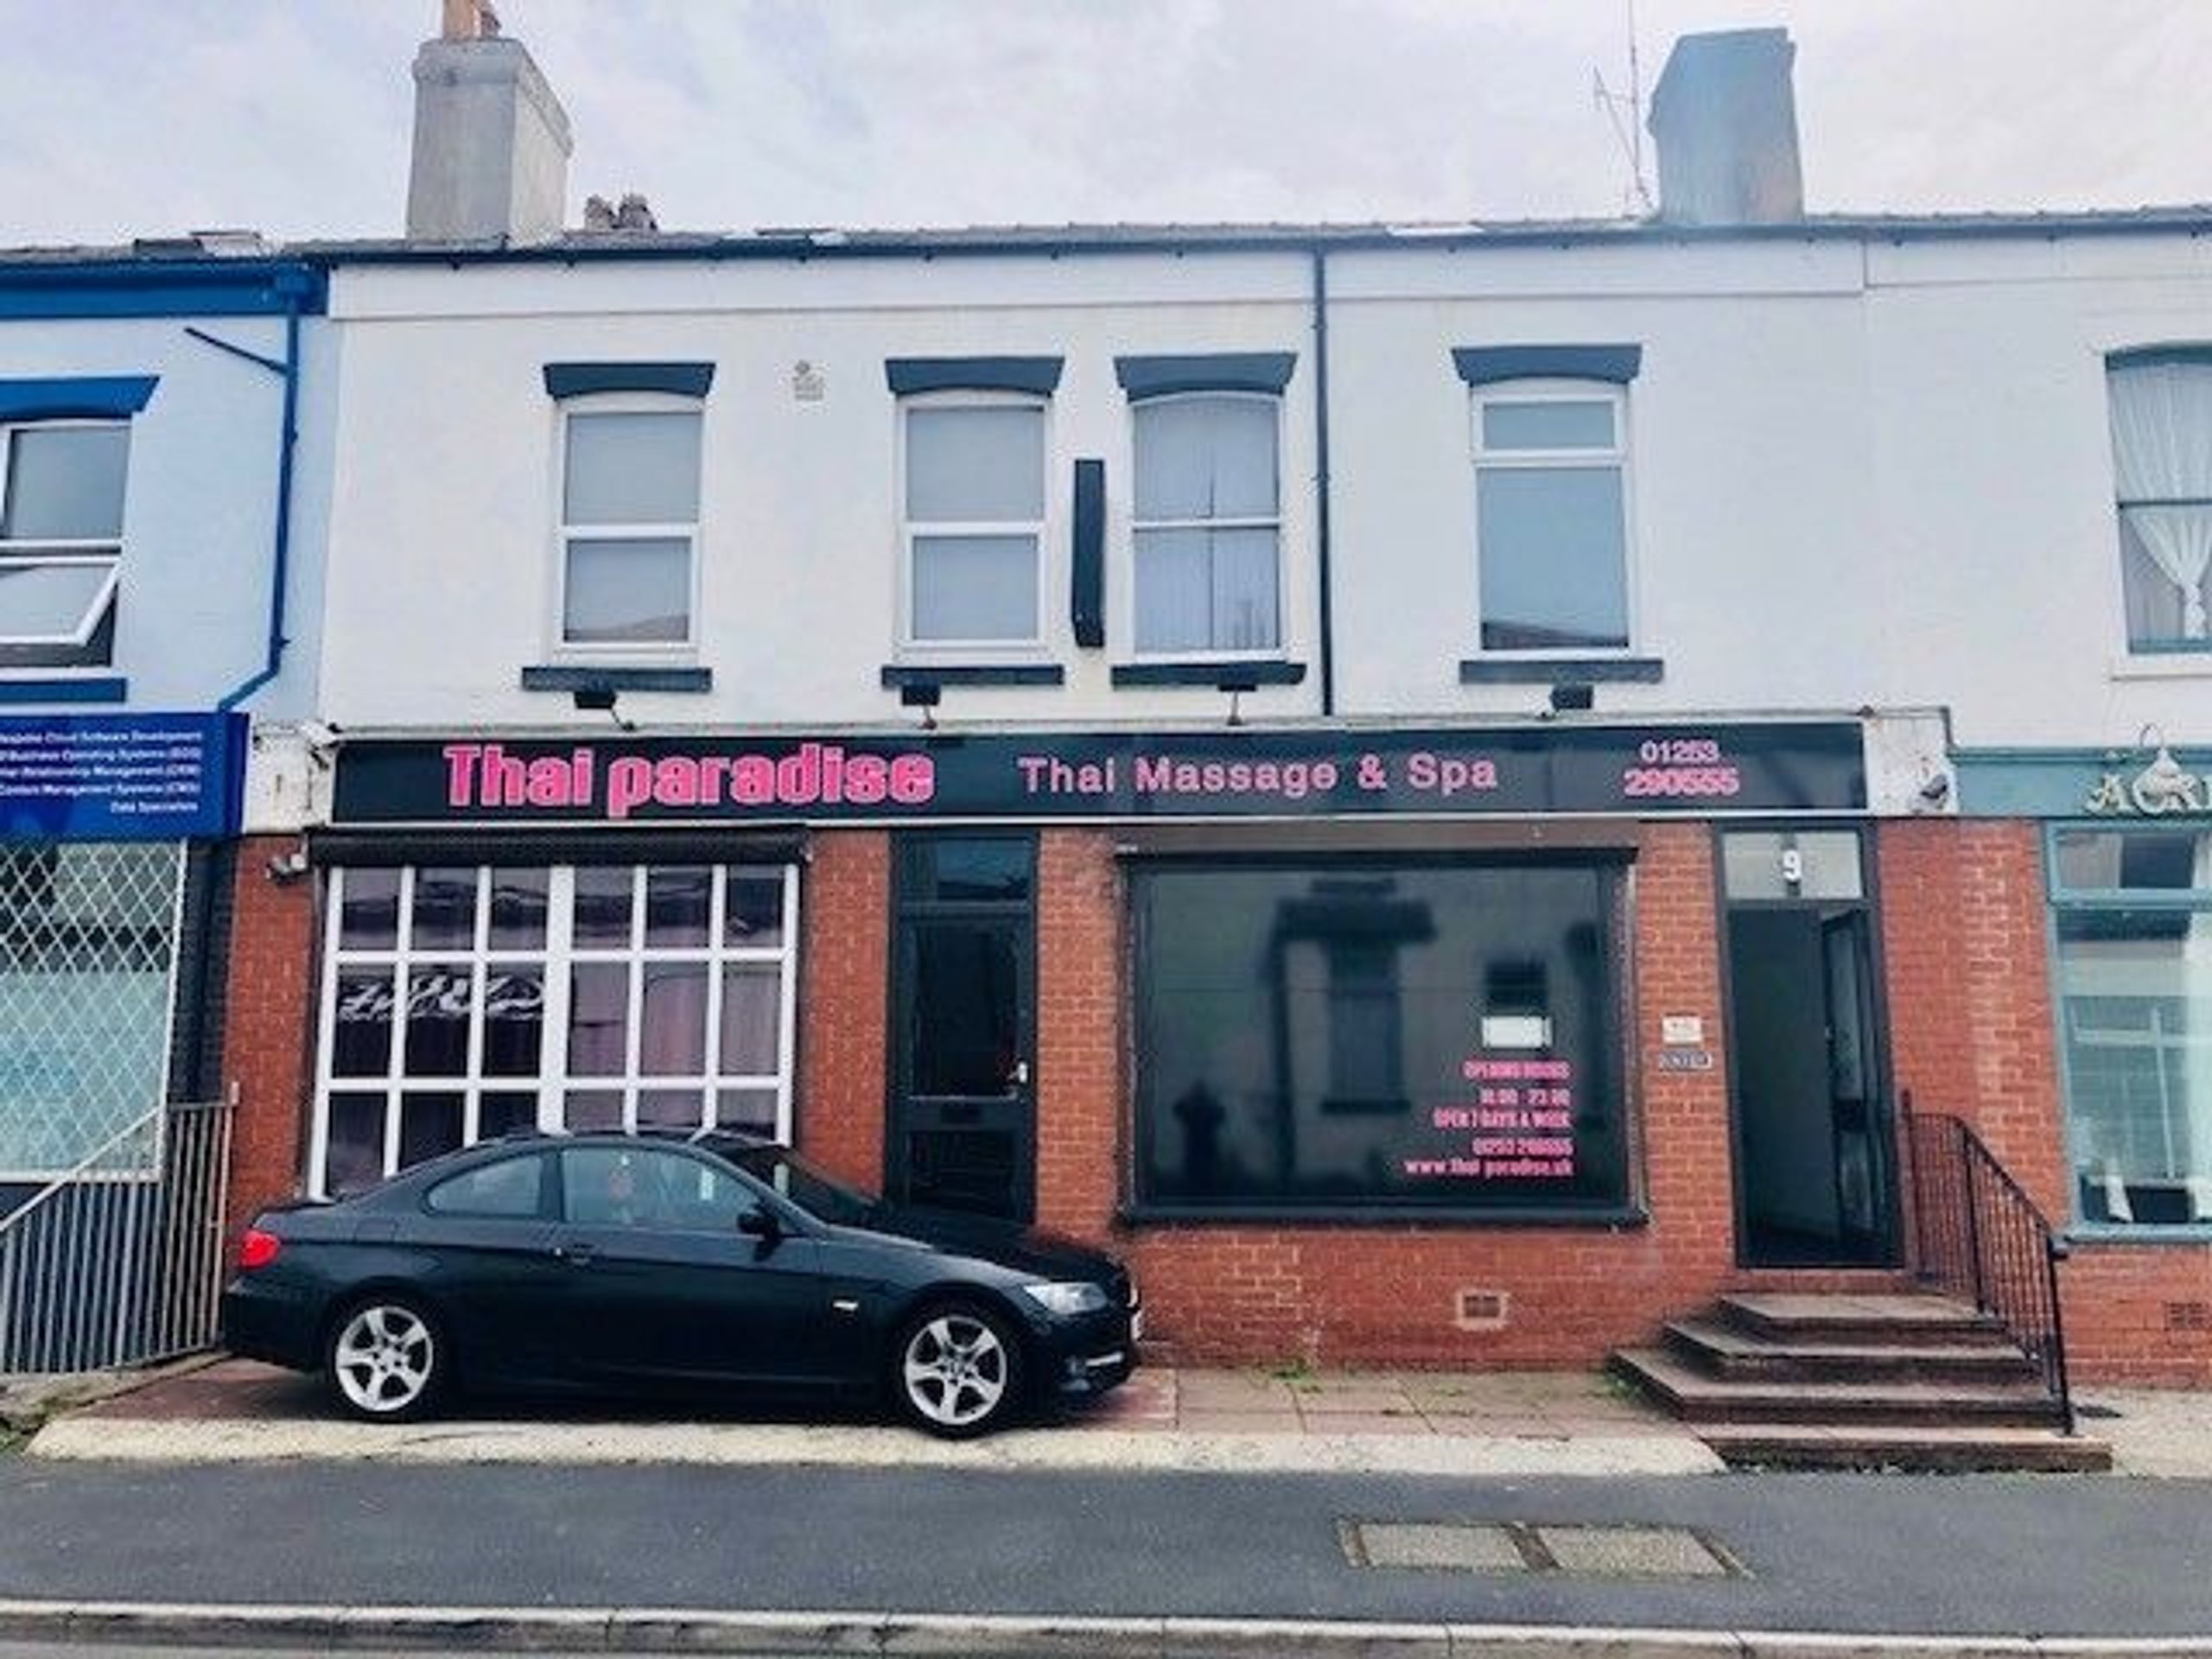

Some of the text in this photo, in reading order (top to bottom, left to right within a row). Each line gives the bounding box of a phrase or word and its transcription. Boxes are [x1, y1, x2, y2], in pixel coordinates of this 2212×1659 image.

[443, 743, 936, 818] Thai paradise
[1017, 751, 1498, 798] Thai Massage & Spa
[1783, 849, 1802, 881] 9
